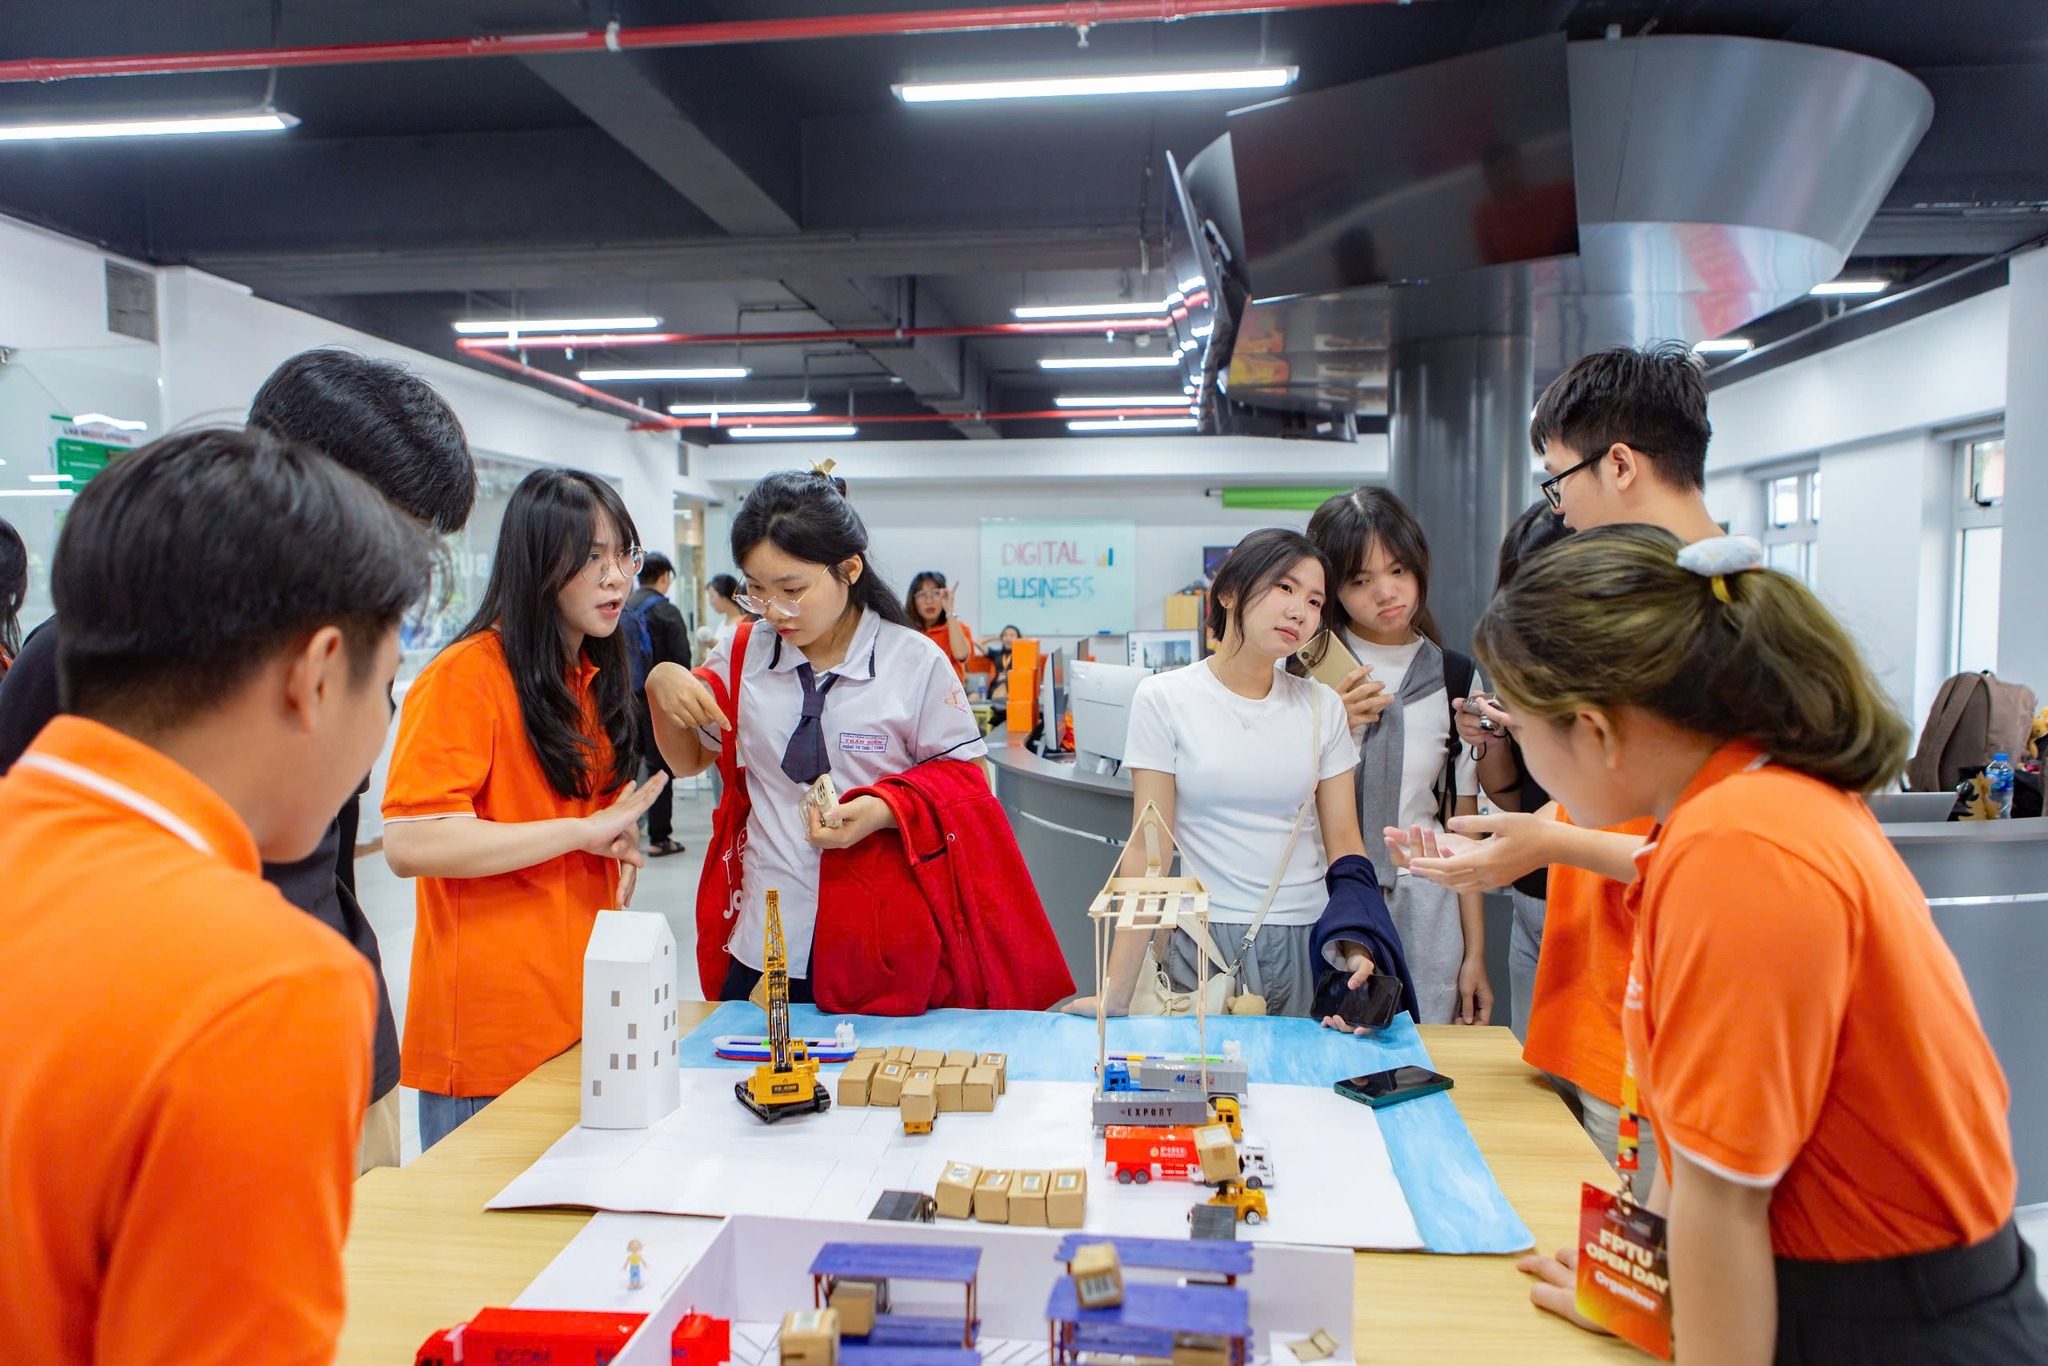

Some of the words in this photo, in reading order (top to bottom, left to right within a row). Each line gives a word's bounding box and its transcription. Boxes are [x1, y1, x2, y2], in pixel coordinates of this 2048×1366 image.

[1001, 541, 1086, 566] DIGITAL
[997, 576, 1094, 599] BUSINESS
[1127, 1107, 1173, 1117] EXPORT
[1600, 1228, 1653, 1269] FPTU
[1585, 1242, 1632, 1277] OPEN
[1632, 1264, 1669, 1295] DAY
